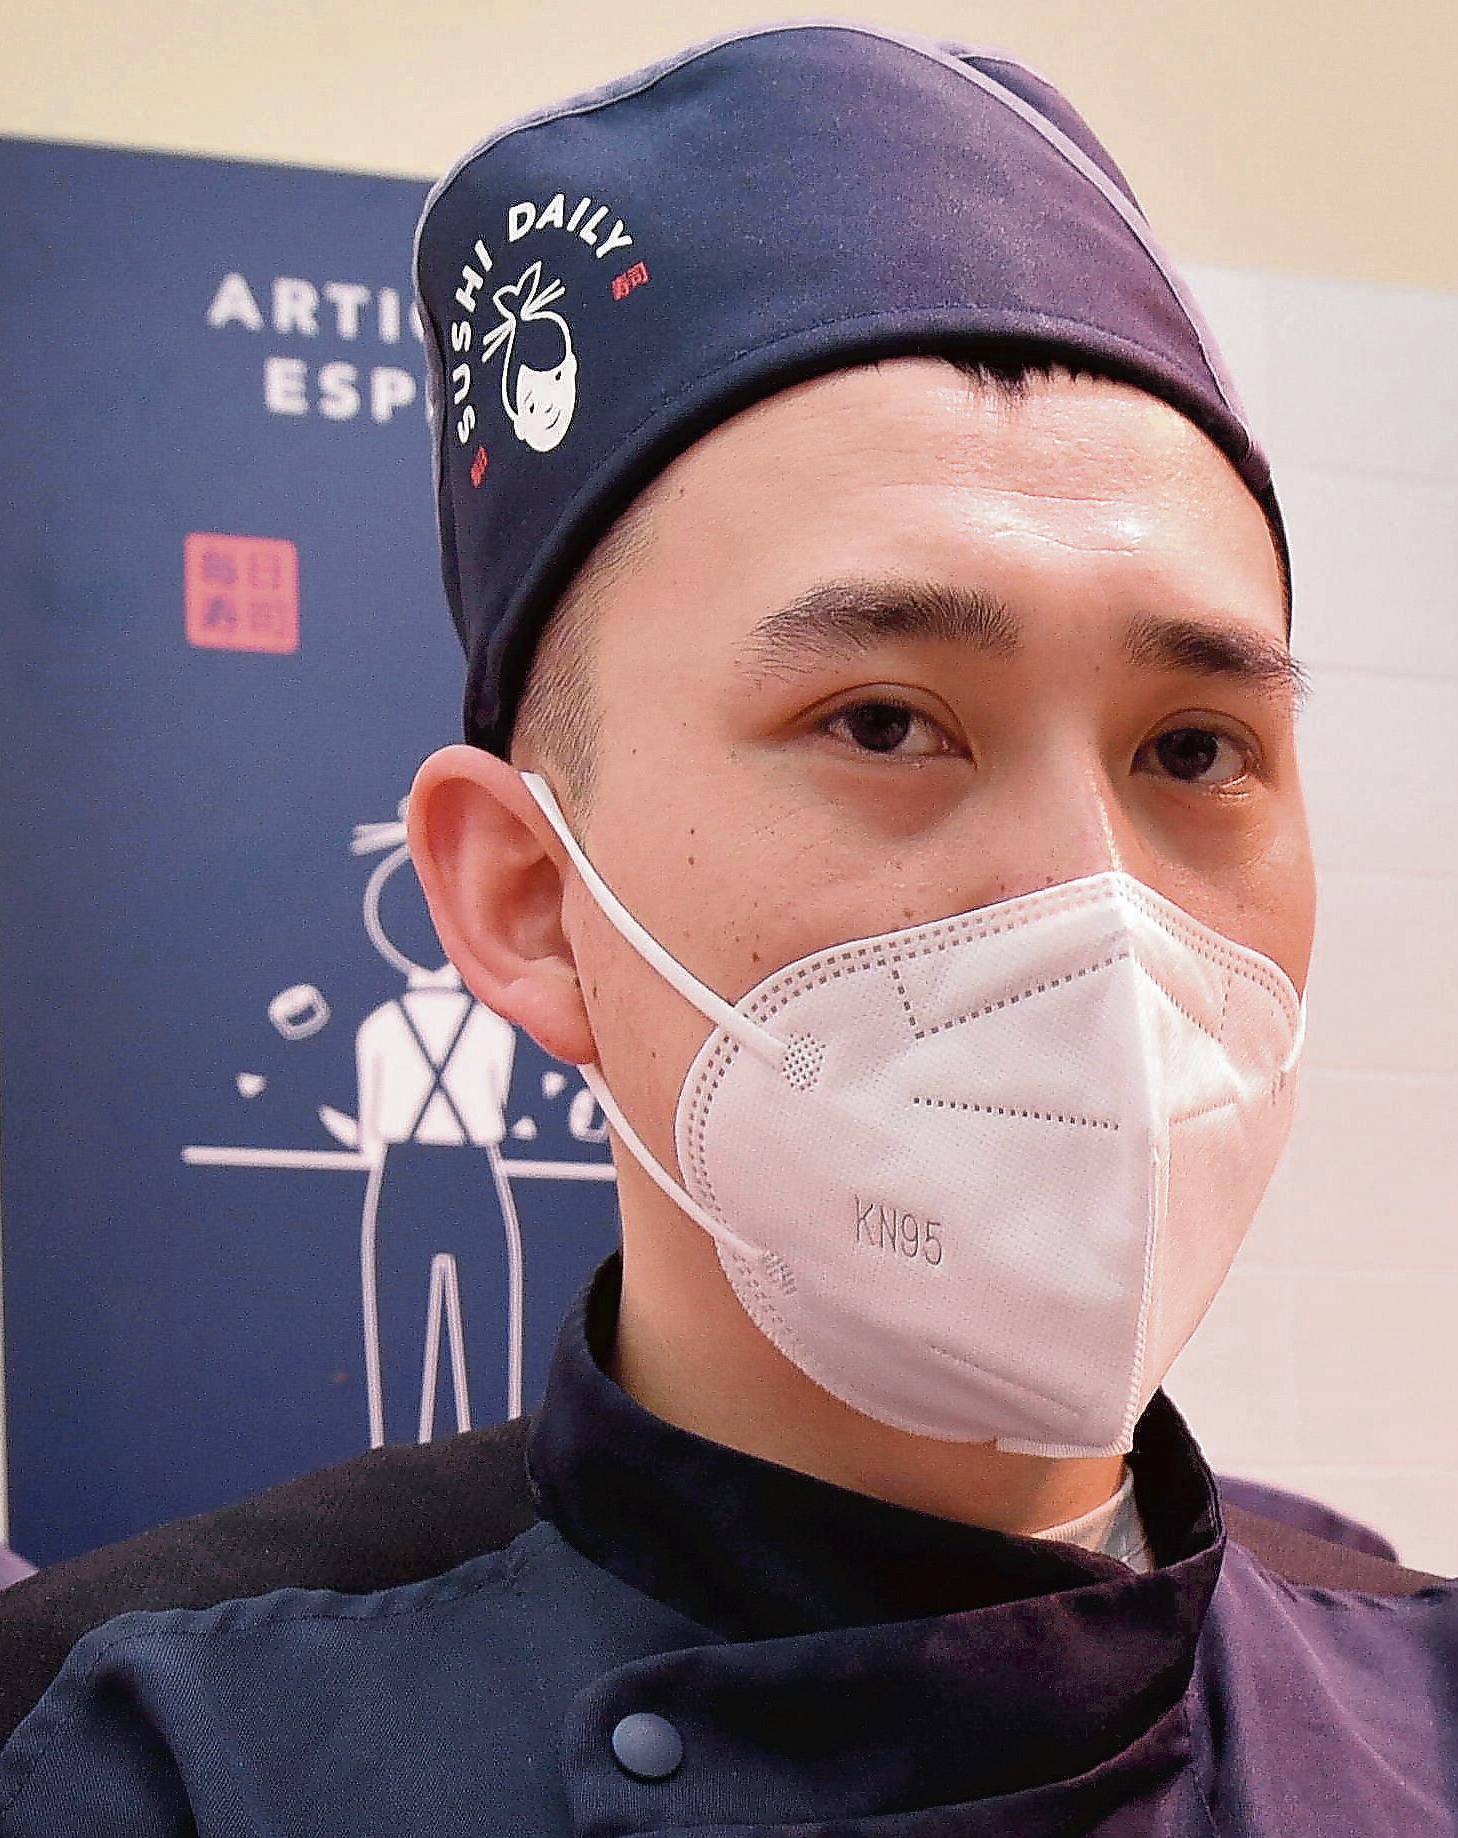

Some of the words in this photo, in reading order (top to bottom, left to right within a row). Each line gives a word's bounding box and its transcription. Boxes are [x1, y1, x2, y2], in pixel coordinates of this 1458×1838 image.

[451, 238, 493, 444] SUSHI
[507, 192, 633, 260] DAILY
[262, 355, 434, 425] ESP
[854, 1193, 943, 1266] KN95
